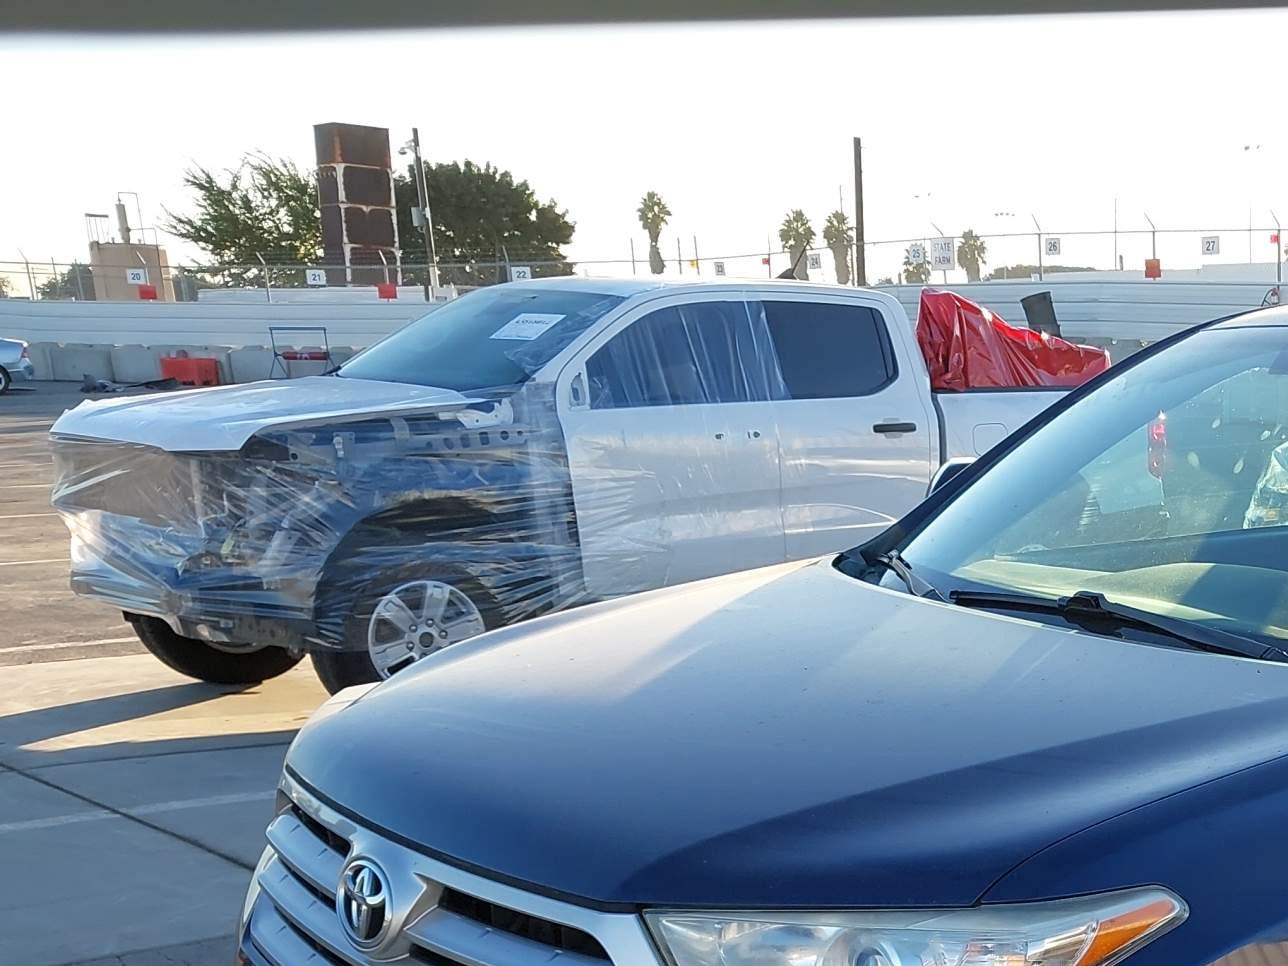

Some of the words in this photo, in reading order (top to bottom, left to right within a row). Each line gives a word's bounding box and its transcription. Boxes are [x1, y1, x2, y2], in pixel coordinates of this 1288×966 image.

[933, 242, 952, 251] STATE
[1048, 241, 1058, 252] 26
[1205, 240, 1216, 251] 27
[911, 248, 921, 258] 25
[811, 257, 819, 267] 24
[933, 256, 951, 265] FARM
[131, 272, 141, 281] 20
[311, 273, 321, 282] 21
[515, 270, 527, 279] 22
